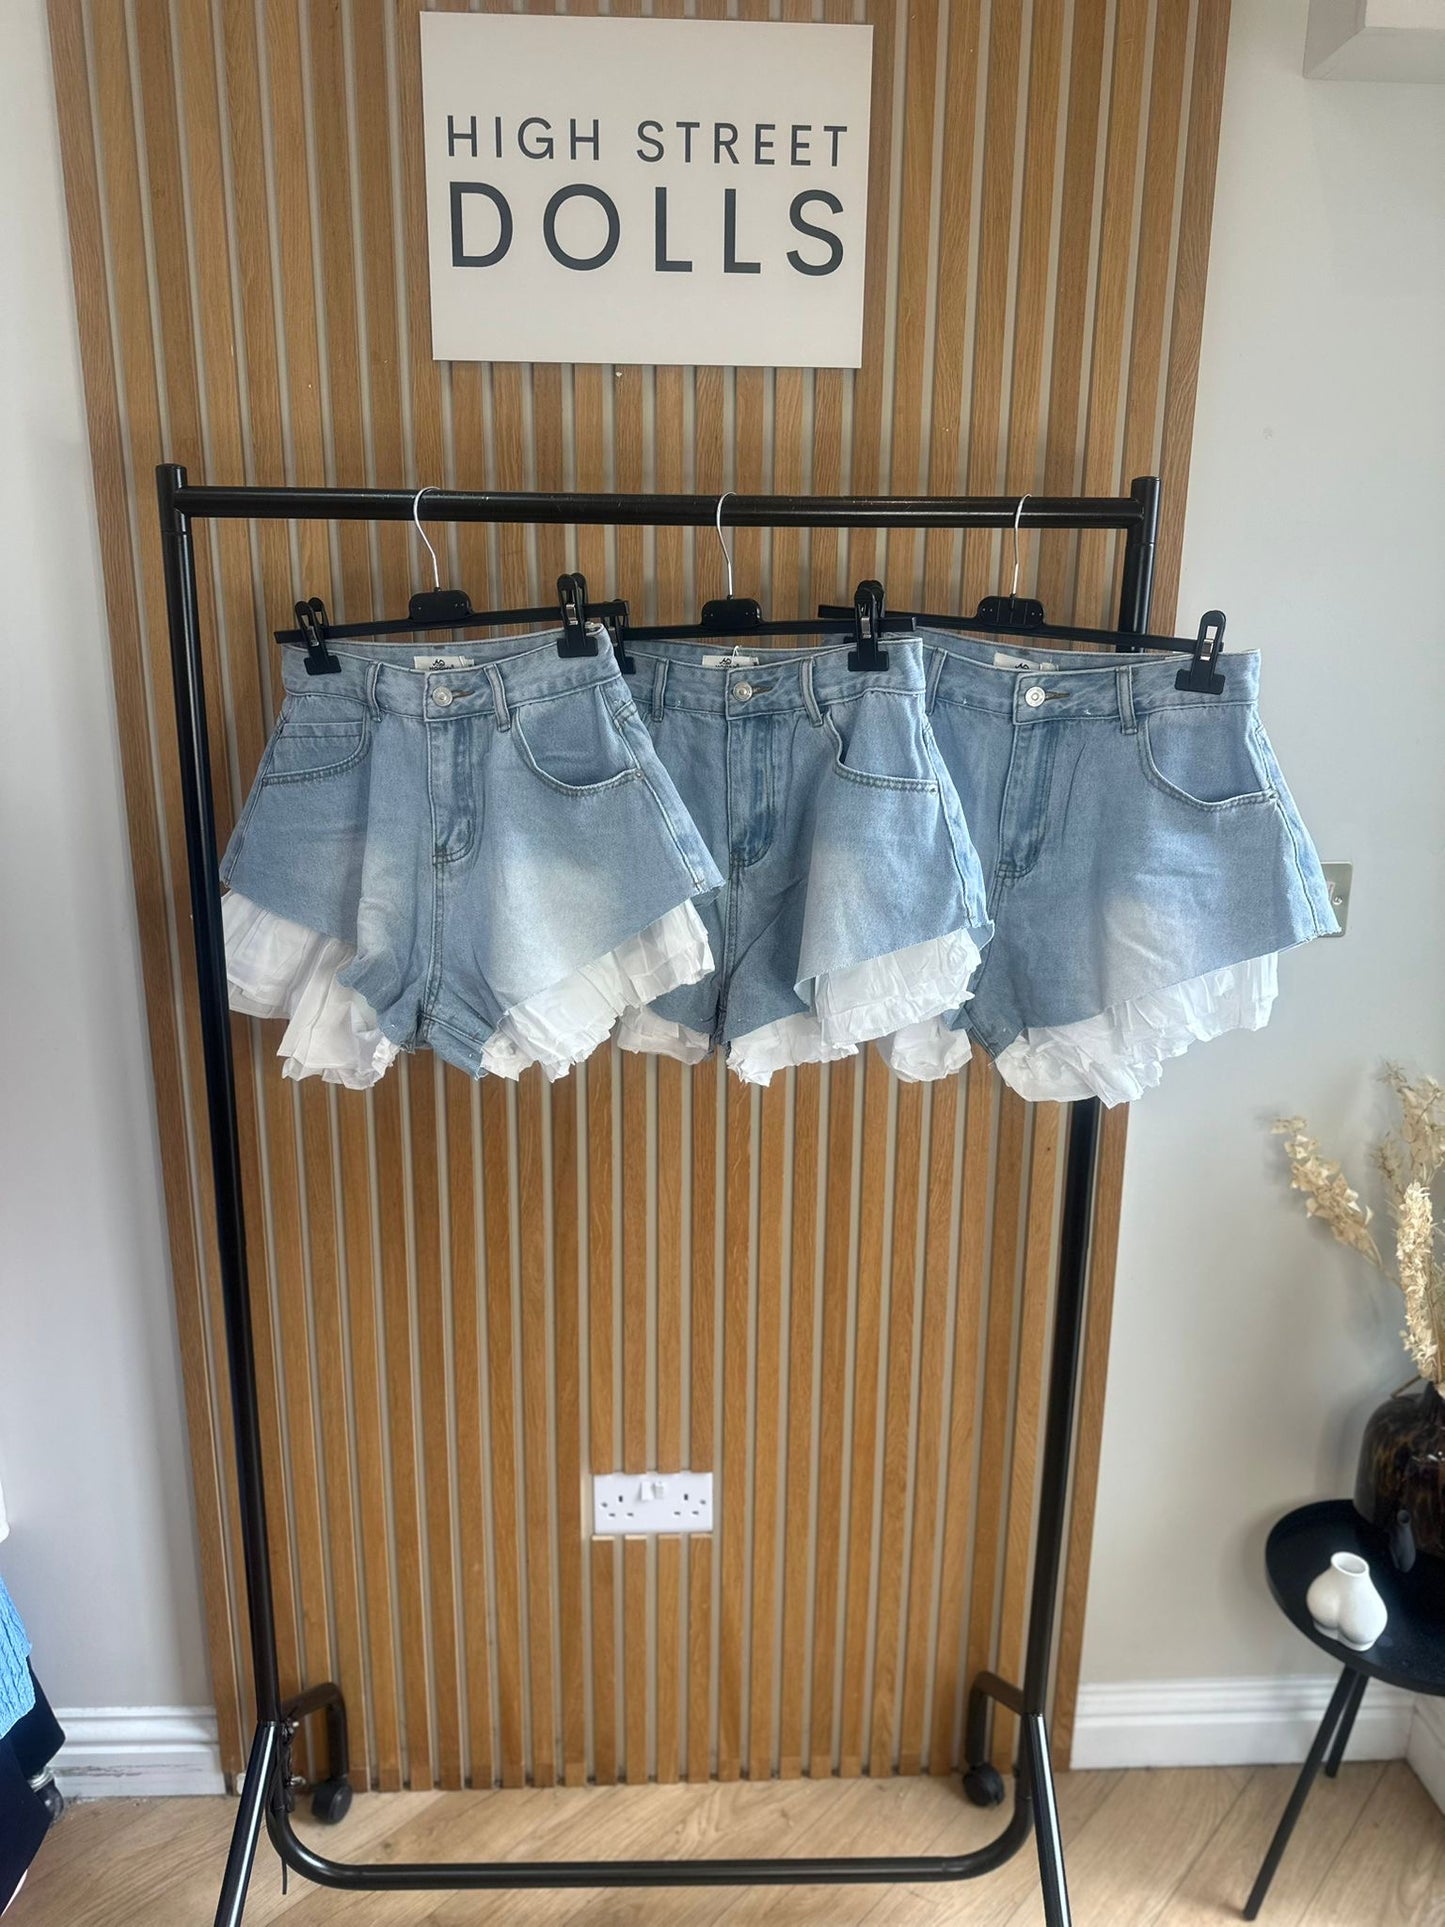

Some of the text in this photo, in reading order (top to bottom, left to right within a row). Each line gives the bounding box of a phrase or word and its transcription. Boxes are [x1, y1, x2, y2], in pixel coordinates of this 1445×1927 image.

[447, 115, 848, 167] HIGH STREET
[449, 181, 844, 276] DOLLS
